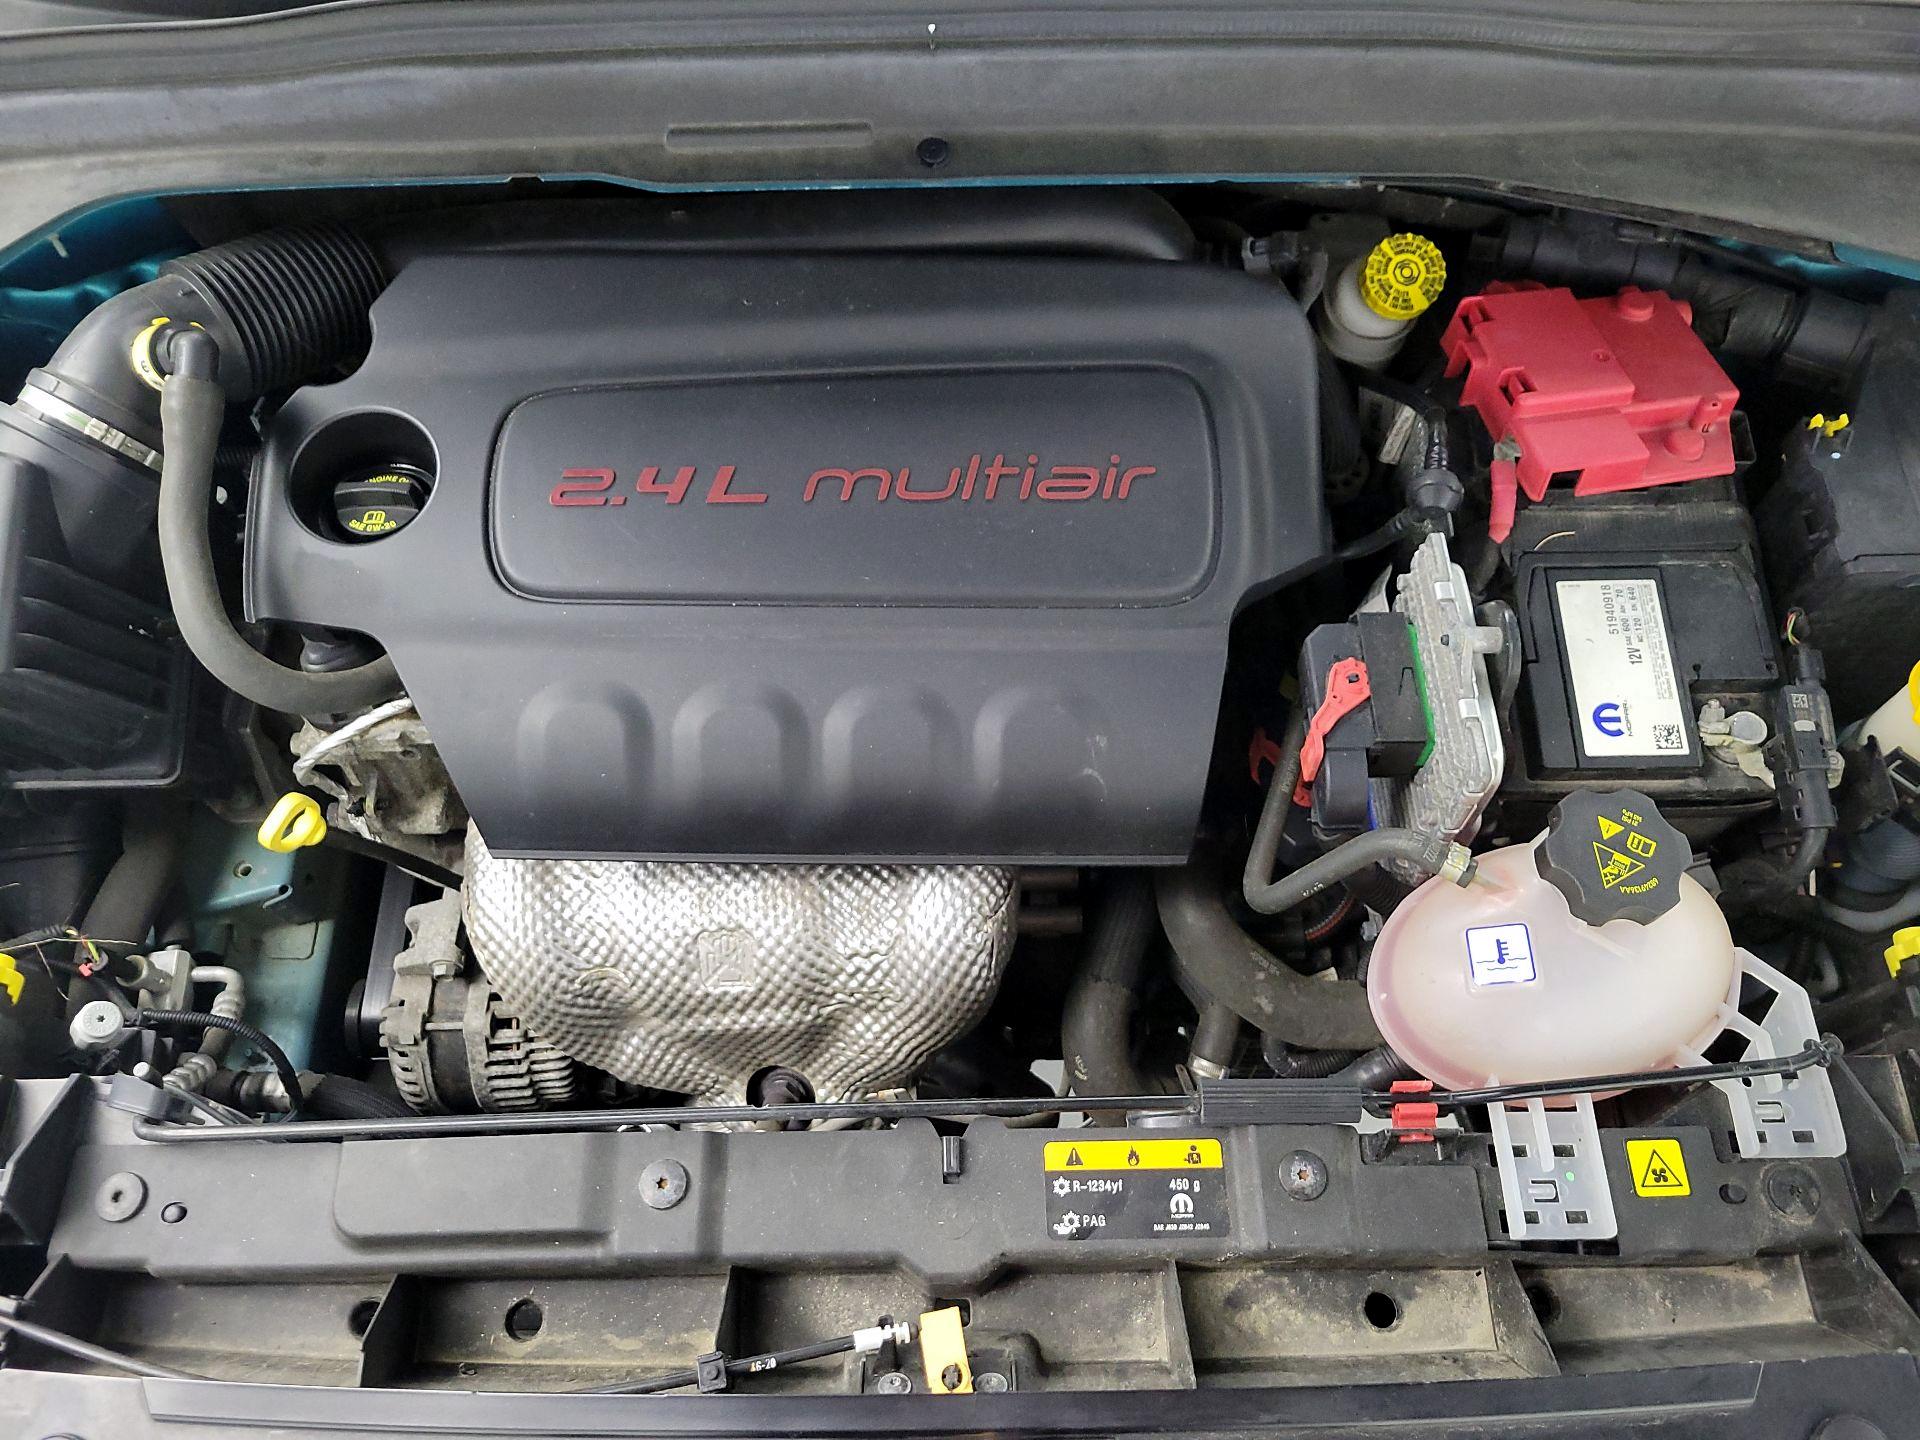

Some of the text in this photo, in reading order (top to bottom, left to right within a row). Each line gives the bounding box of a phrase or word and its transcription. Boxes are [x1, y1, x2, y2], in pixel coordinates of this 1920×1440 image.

[803, 454, 1157, 502] multiair
[349, 519, 397, 532] SAE 0W-20
[1616, 588, 1623, 598] 70
[1627, 586, 1636, 600] 640
[1601, 584, 1619, 635] 51940918
[1620, 618, 1630, 632] 600
[1634, 618, 1642, 631] 120
[1627, 647, 1643, 665] 12V
[1169, 1178, 1190, 1190] 450
[1194, 1180, 1200, 1192] g
[1082, 1214, 1106, 1227] PAG
